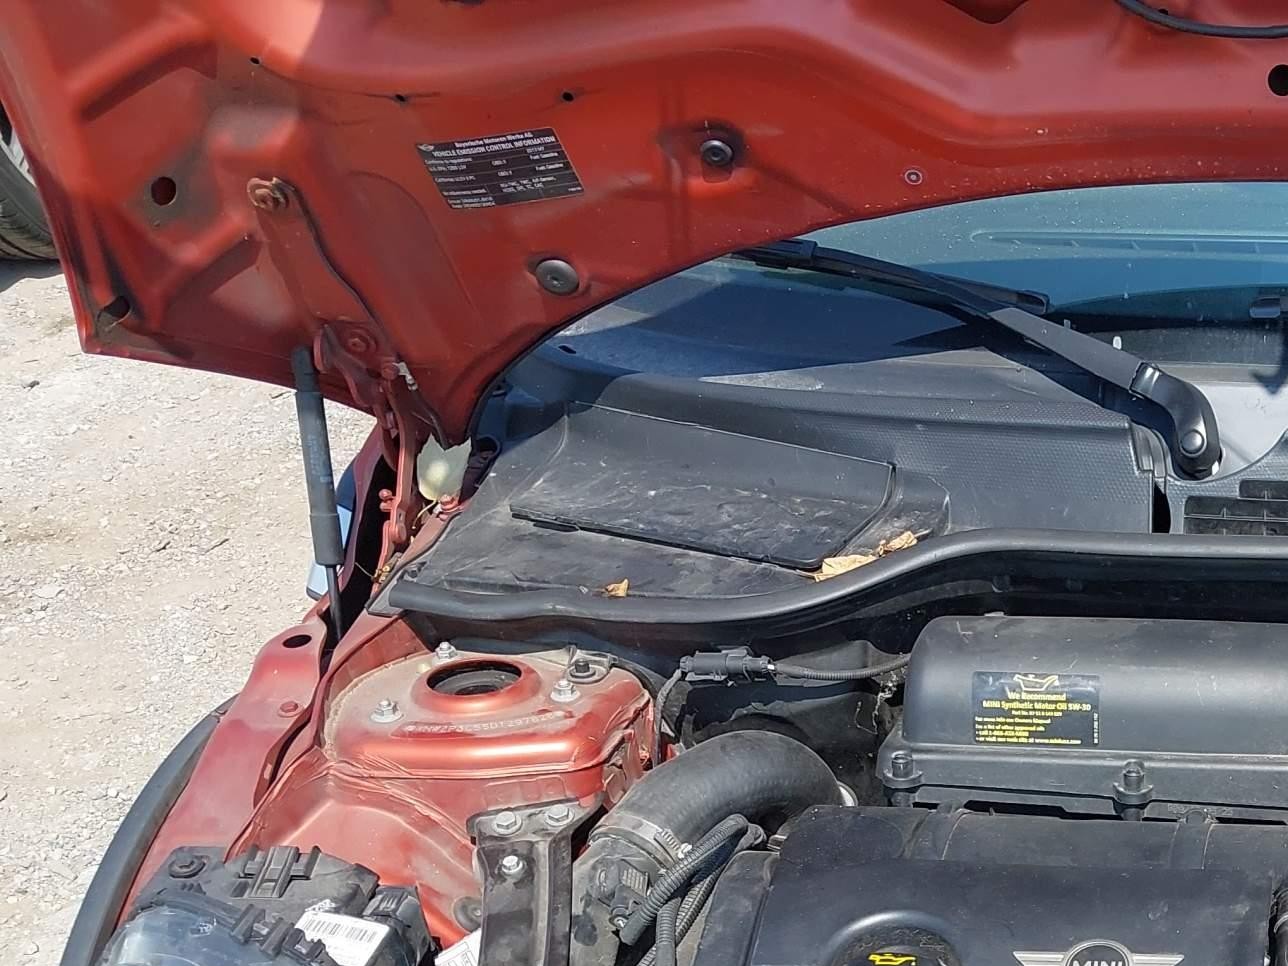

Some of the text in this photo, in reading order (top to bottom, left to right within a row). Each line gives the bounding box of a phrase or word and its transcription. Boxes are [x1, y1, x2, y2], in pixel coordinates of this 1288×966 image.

[456, 147, 486, 156] EMISSION
[485, 143, 514, 152] CONTROL
[513, 136, 556, 148] INFORMATION
[1007, 691, 1067, 701] We Recommend
[1001, 701, 1033, 710] Synthetic
[1034, 702, 1056, 710] Motor
[1067, 703, 1092, 712] 5W-30
